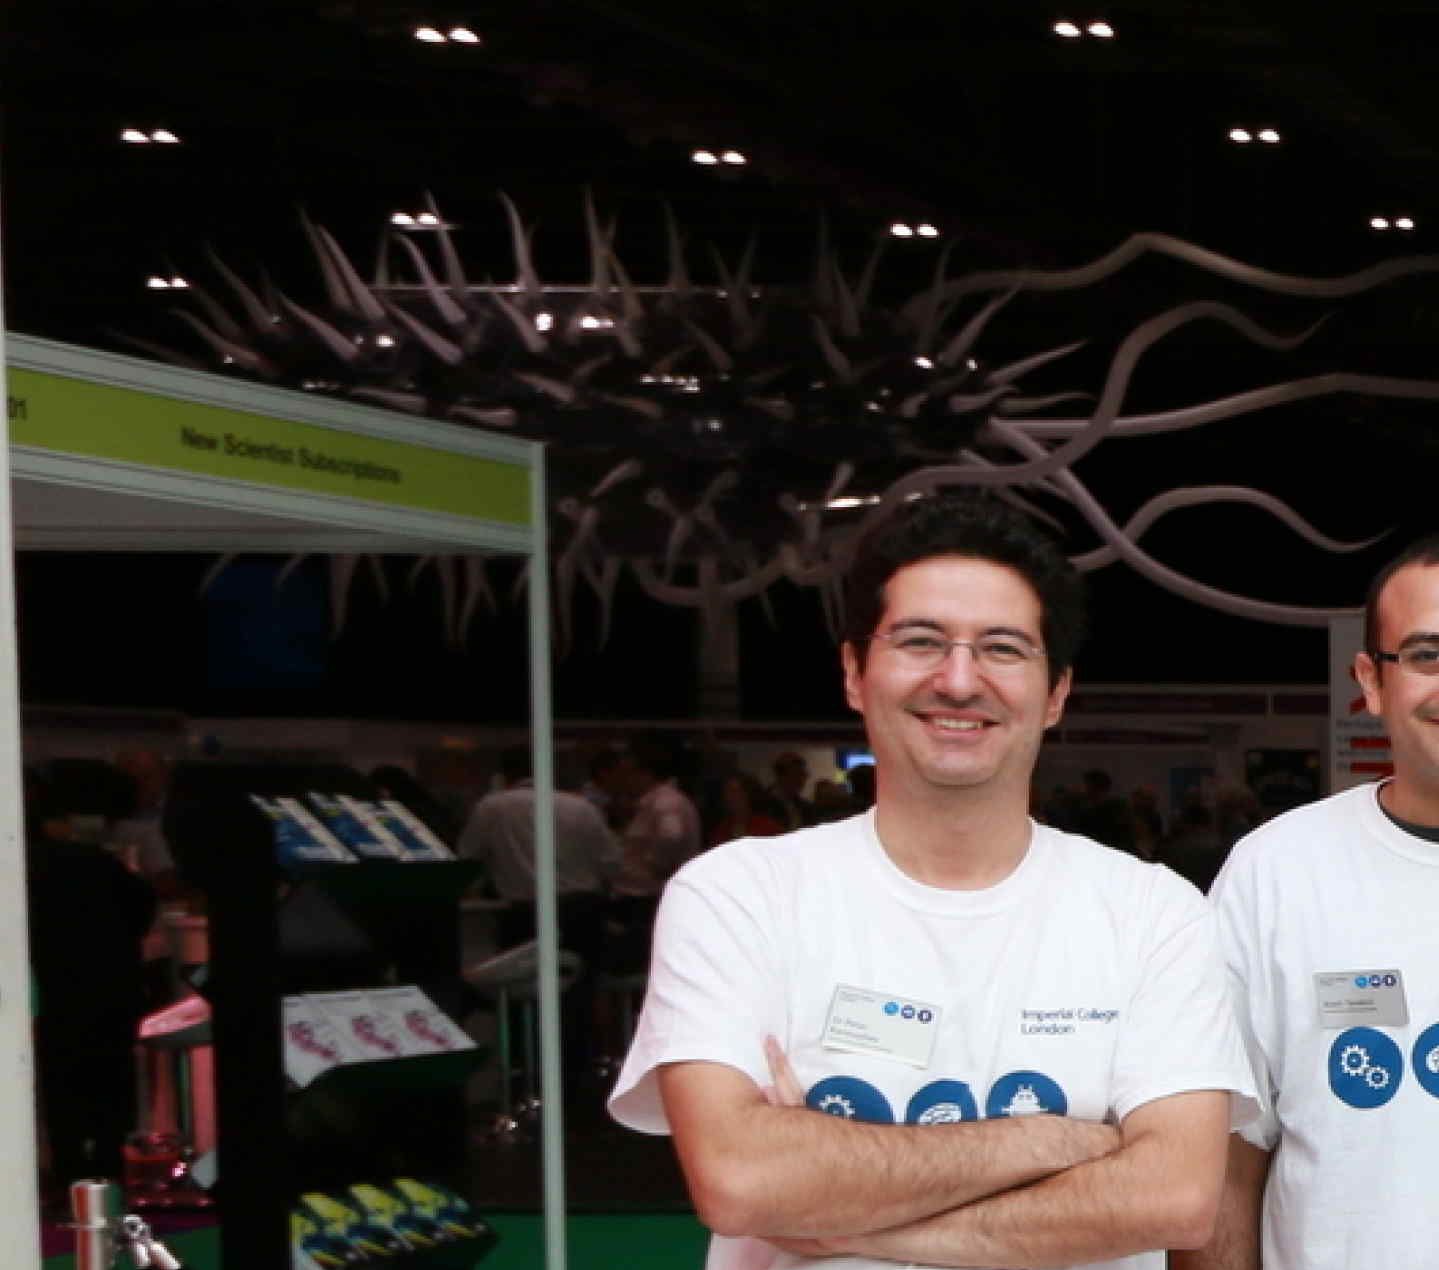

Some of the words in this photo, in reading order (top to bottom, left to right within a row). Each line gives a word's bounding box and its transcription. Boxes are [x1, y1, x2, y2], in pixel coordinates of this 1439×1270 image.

[181, 426, 218, 451] New
[224, 433, 294, 465] Scientist
[299, 447, 401, 484] Subscriptions
[1022, 1007, 1074, 1022] Imperial
[1021, 1023, 1076, 1035] London
